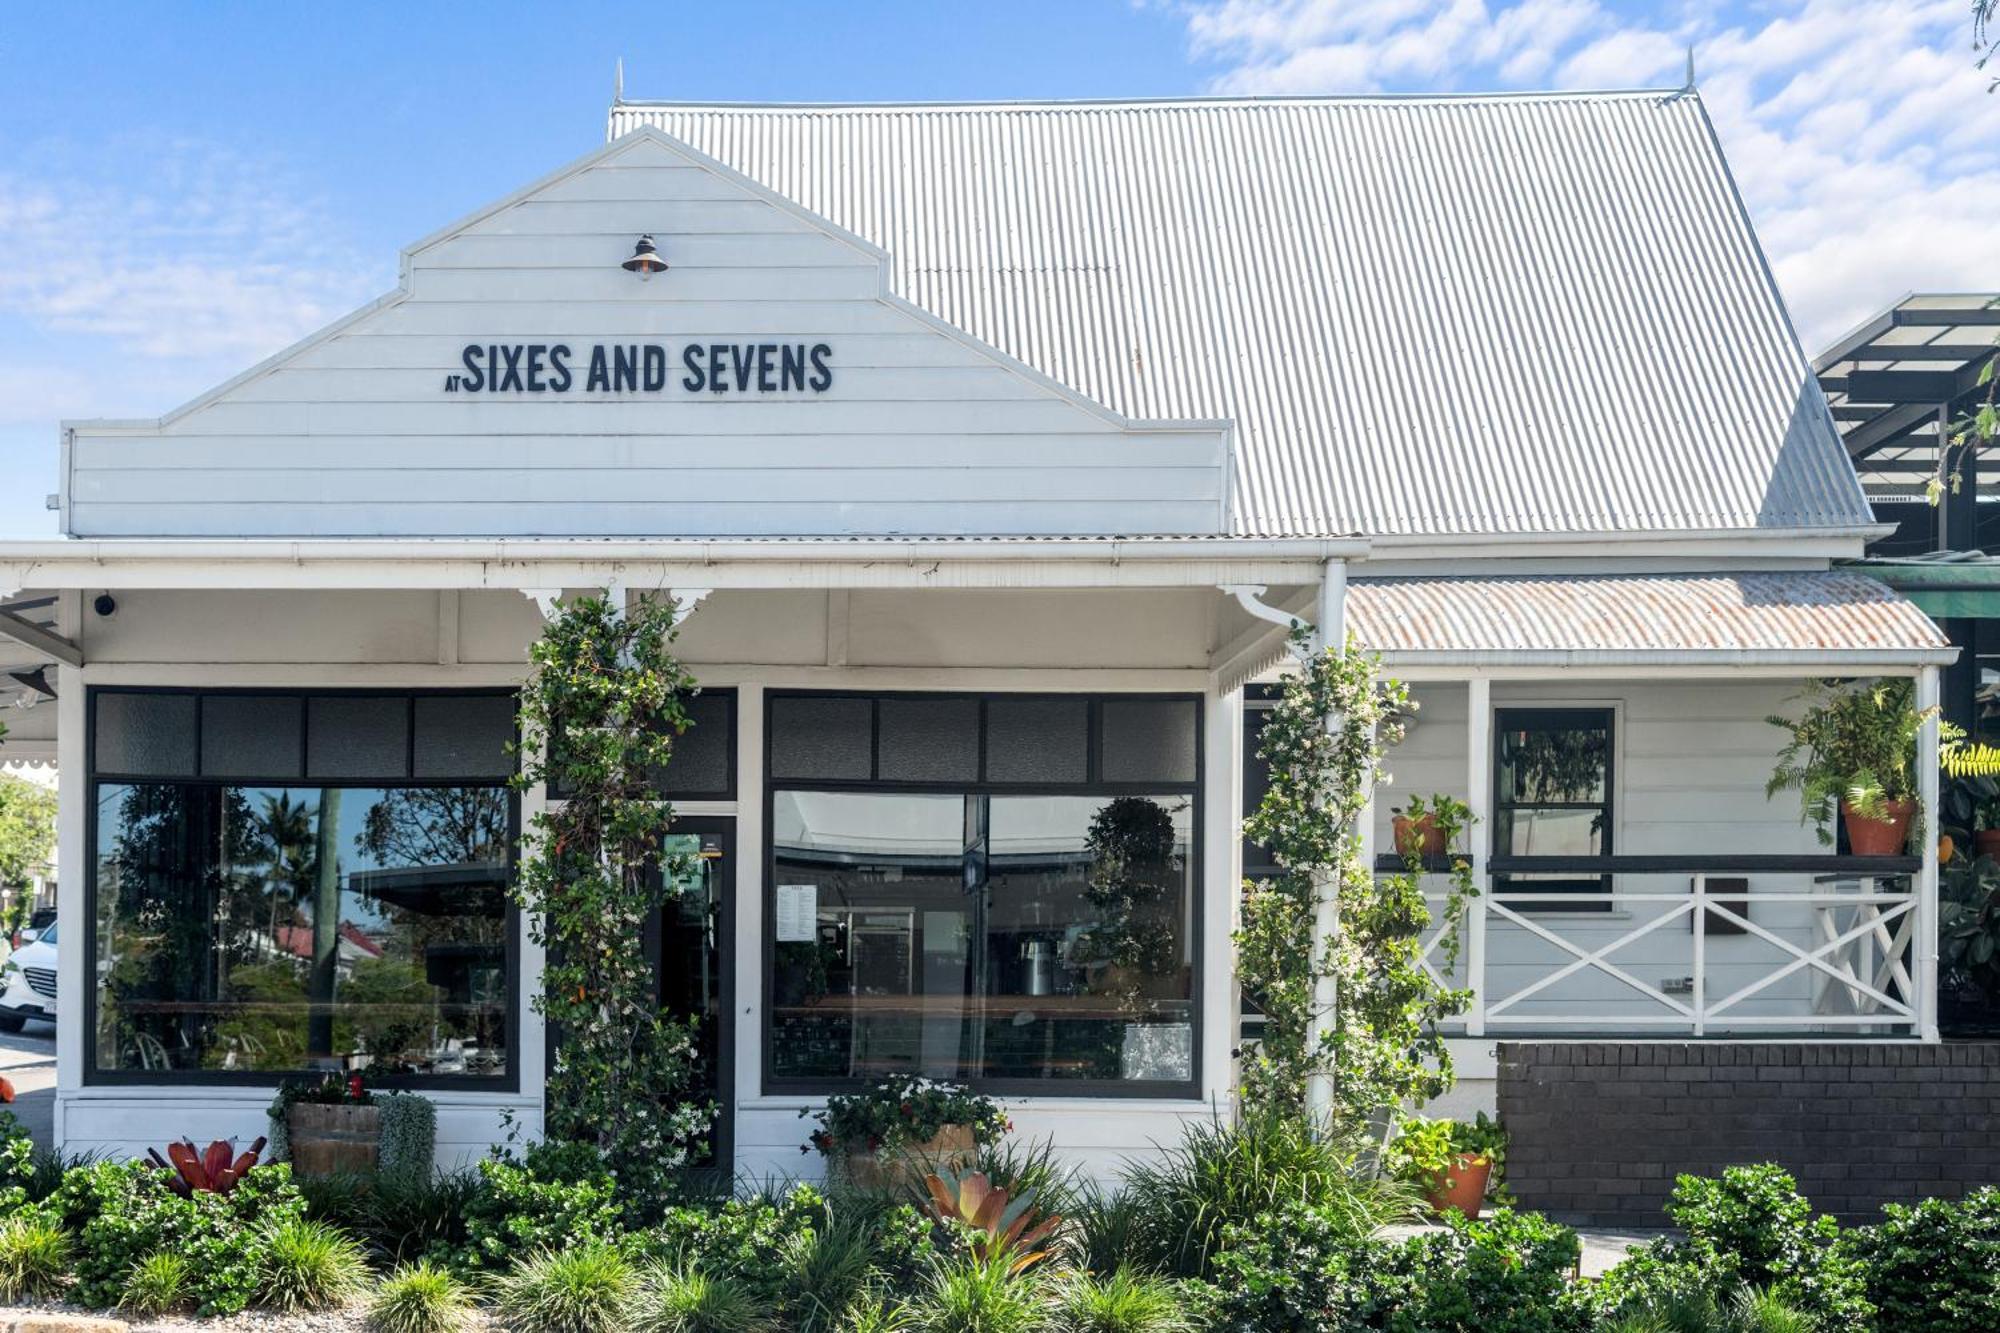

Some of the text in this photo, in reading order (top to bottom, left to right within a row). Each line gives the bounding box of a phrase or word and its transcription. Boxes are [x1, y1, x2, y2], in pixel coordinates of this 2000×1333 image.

[444, 343, 834, 394] AT SIXES AND SEVENS
